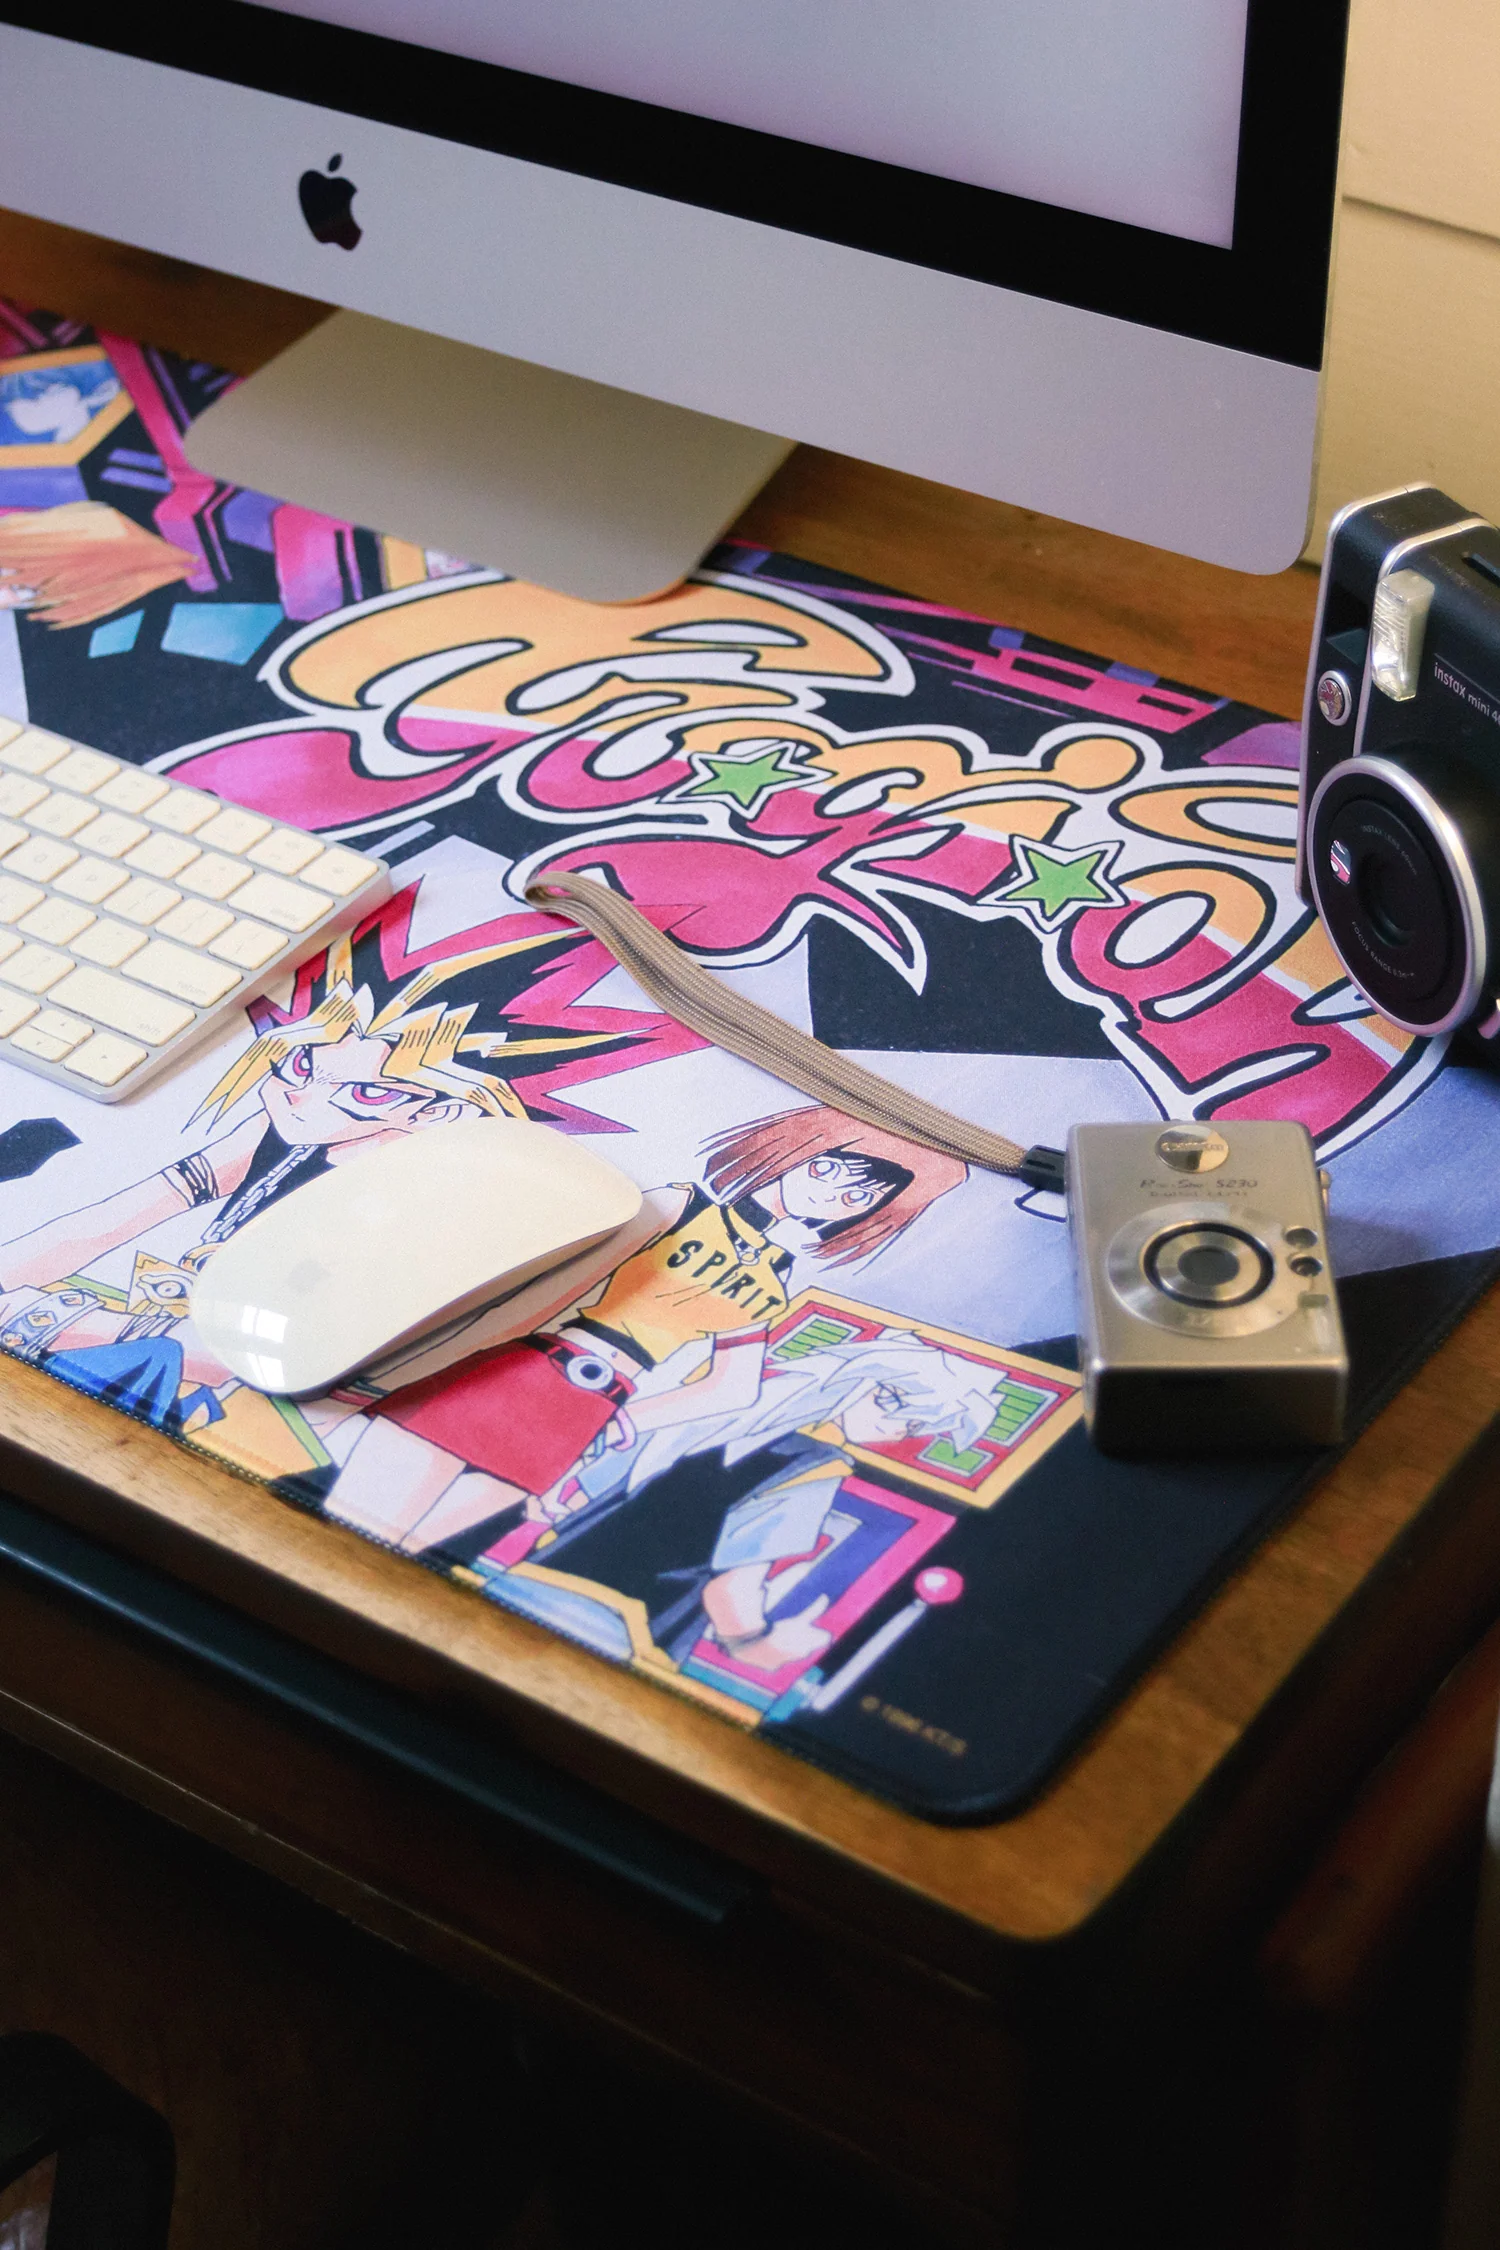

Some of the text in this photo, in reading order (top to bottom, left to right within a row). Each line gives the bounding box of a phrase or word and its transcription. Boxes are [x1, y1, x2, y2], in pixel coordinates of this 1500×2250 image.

[1433, 661, 1466, 699] instax
[1467, 693, 1490, 717] mini
[666, 1239, 783, 1320] SPIRIT
